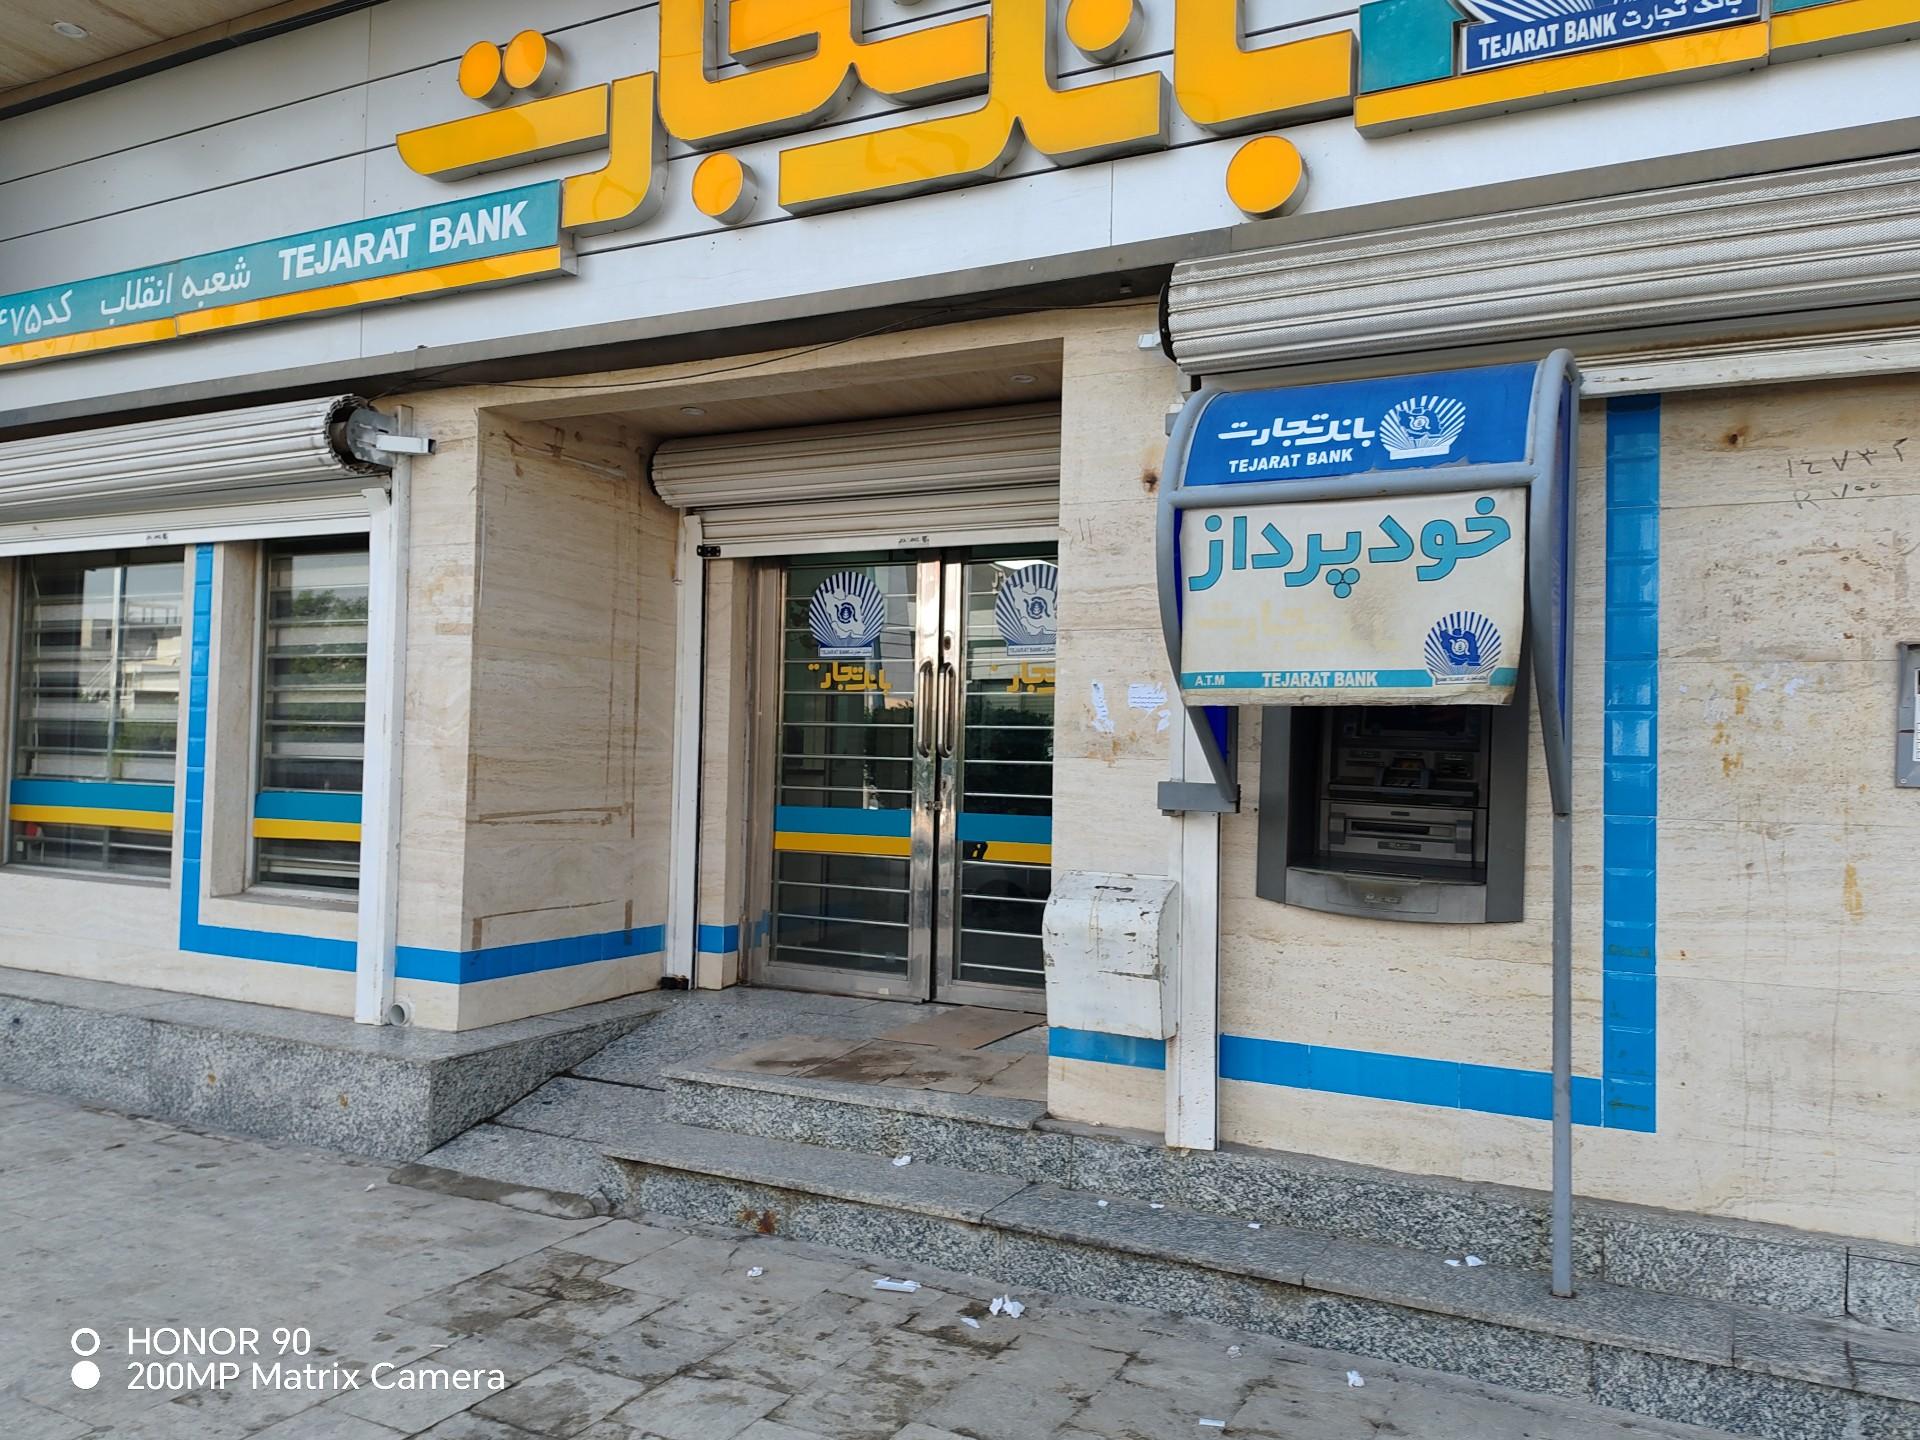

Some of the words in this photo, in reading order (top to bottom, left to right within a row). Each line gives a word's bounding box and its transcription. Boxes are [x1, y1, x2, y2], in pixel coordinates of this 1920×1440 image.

[1478, 23, 1559, 61] TEJARAT
[1564, 12, 1617, 45] BANK
[278, 223, 416, 281] TEJARAT
[429, 200, 529, 254] BANK
[100, 272, 173, 325] انقلاب
[181, 256, 251, 308] شعبه
[1217, 413, 1330, 447] تجارت
[1294, 416, 1376, 448] بانک
[1228, 453, 1301, 474] TEJARAT
[1306, 448, 1354, 466] BANK
[807, 661, 864, 691] تجار
[1194, 674, 1225, 687] A.T.M
[1261, 671, 1330, 688] TEJARAT
[1333, 671, 1378, 687] BANK
